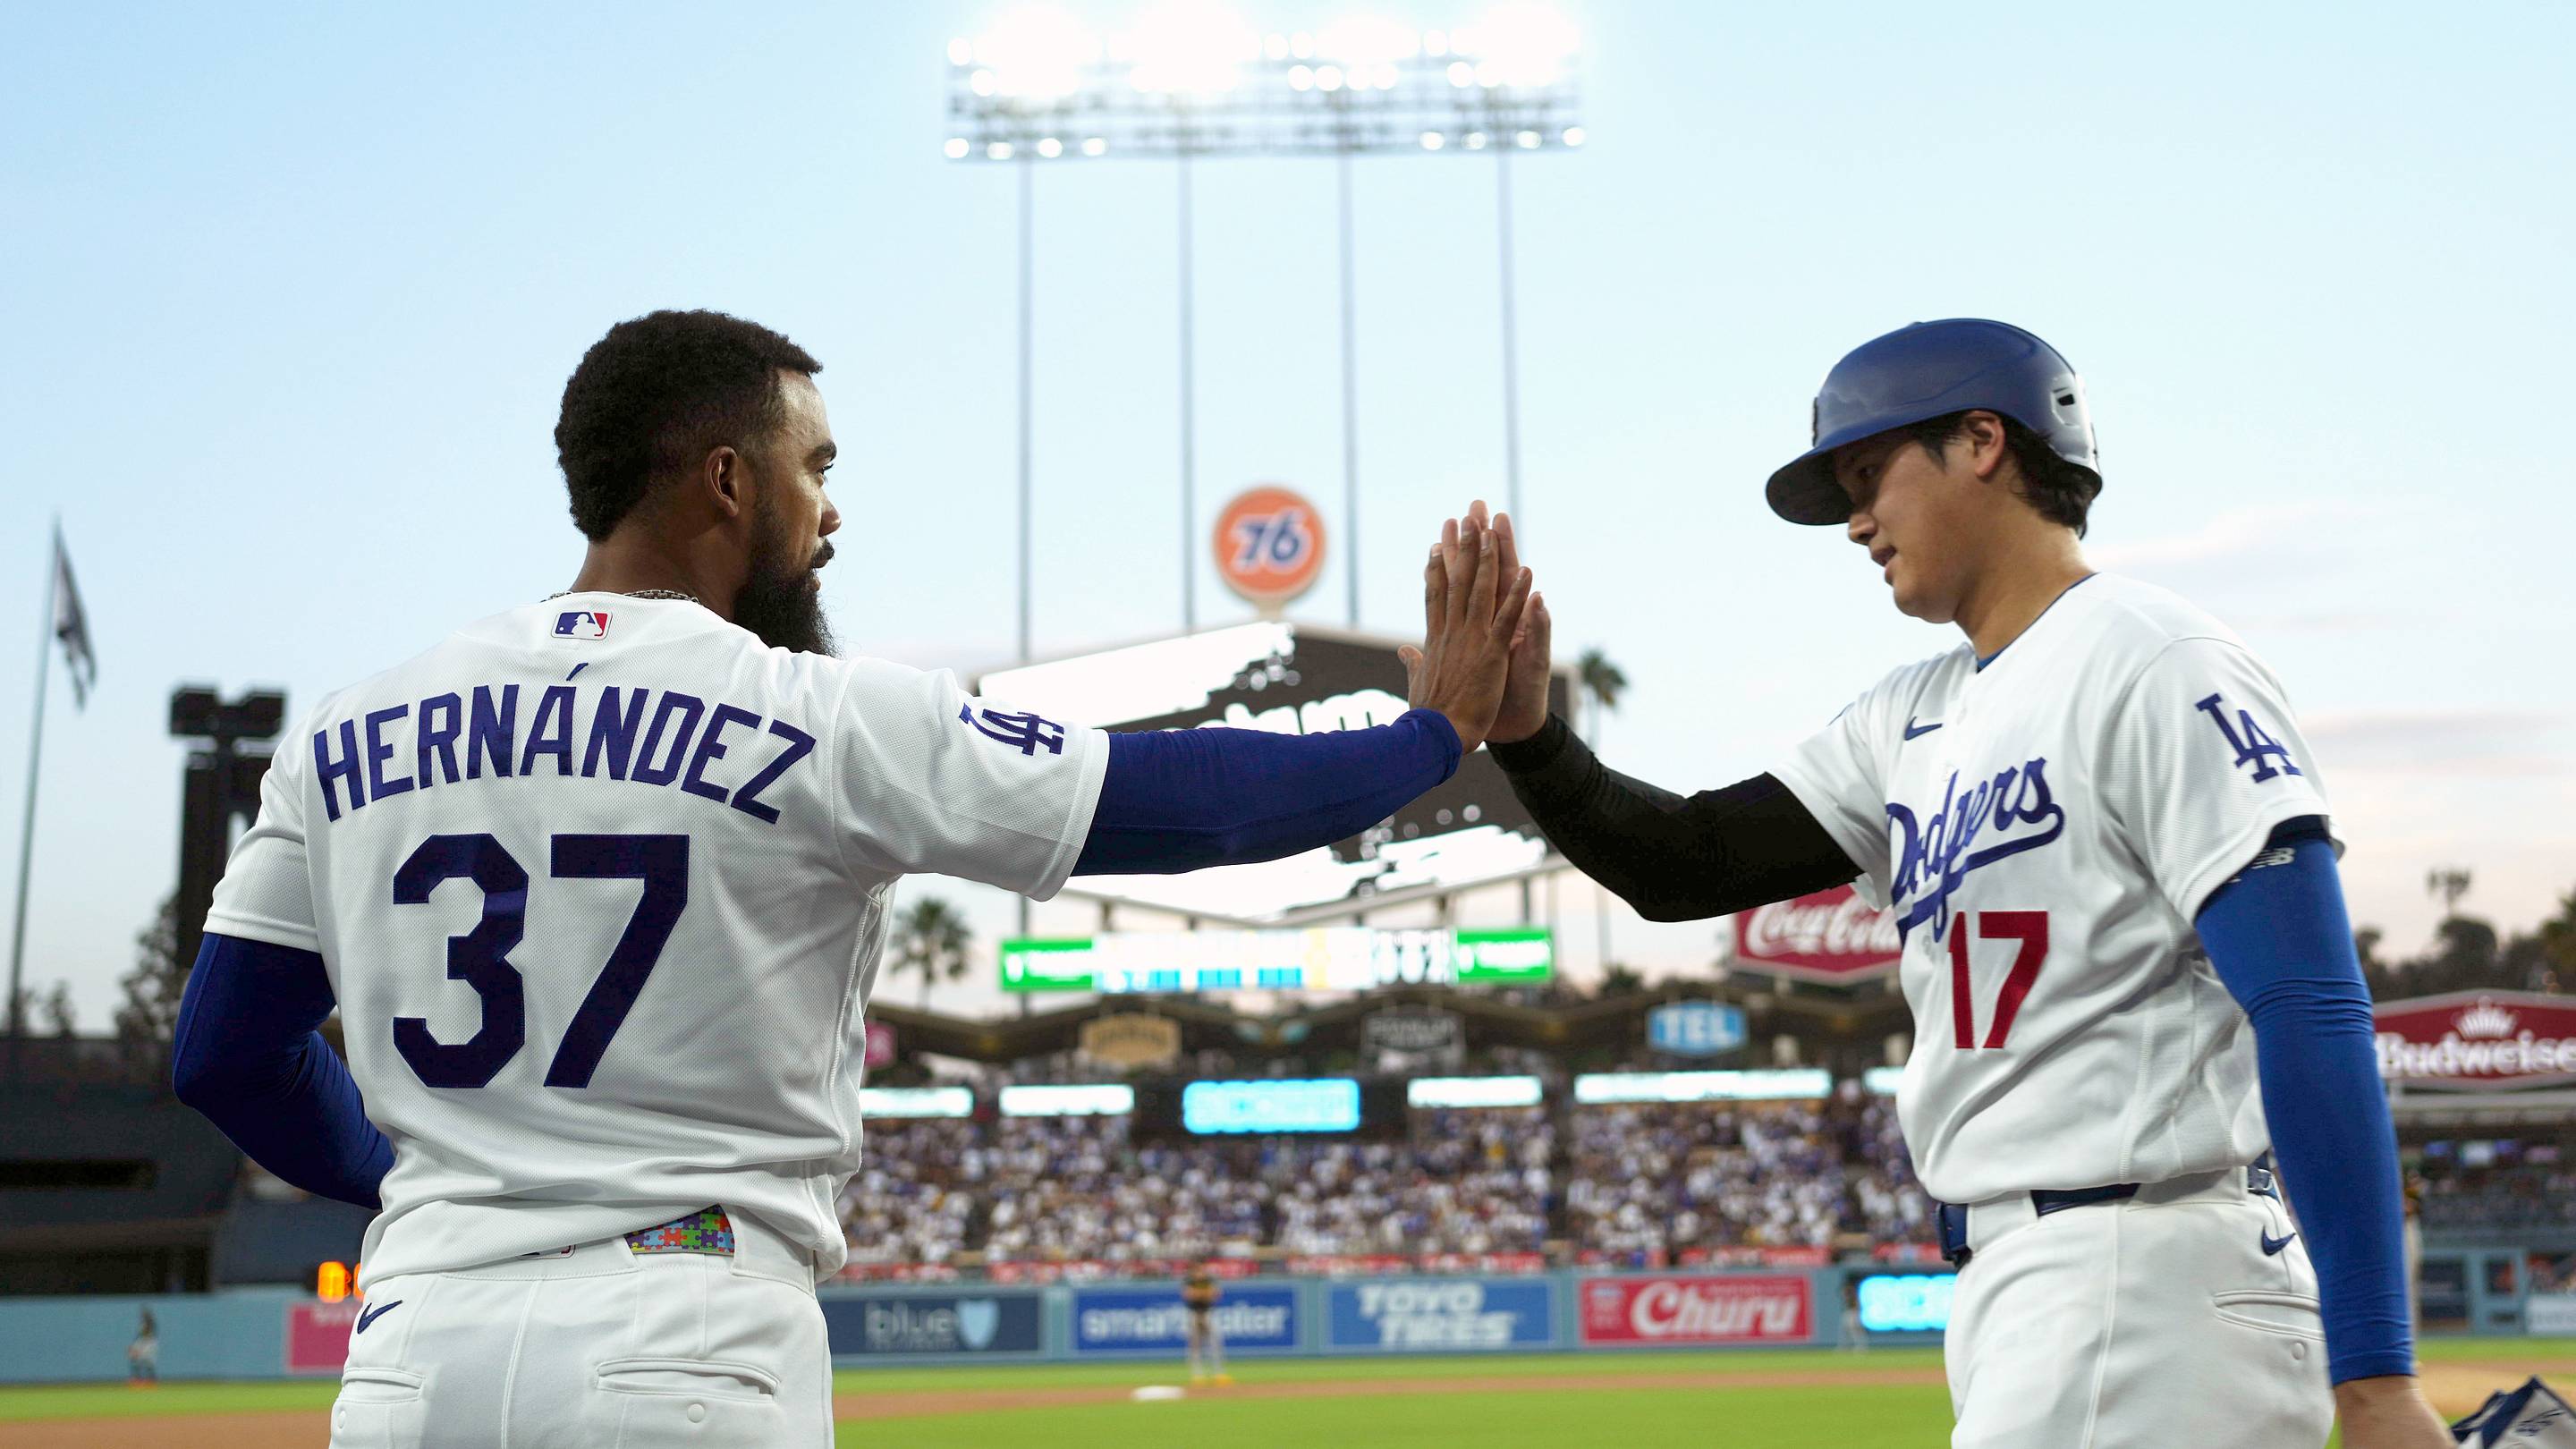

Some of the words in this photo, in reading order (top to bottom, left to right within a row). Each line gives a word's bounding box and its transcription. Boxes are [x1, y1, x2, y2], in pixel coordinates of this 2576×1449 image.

[1234, 508, 1309, 571] 76
[313, 663, 816, 824] HERNÁNDEZ
[2195, 692, 2305, 784] LA
[1885, 758, 2064, 945] Dodgers
[393, 834, 690, 1088] 37
[1948, 911, 2049, 1049] 17
[1654, 1006, 1740, 1047] TEL
[865, 1301, 960, 1343] blue
[1358, 1281, 1485, 1320] TOYO
[1378, 1310, 1518, 1349] TIRES
[1630, 1280, 1799, 1336] Churu
